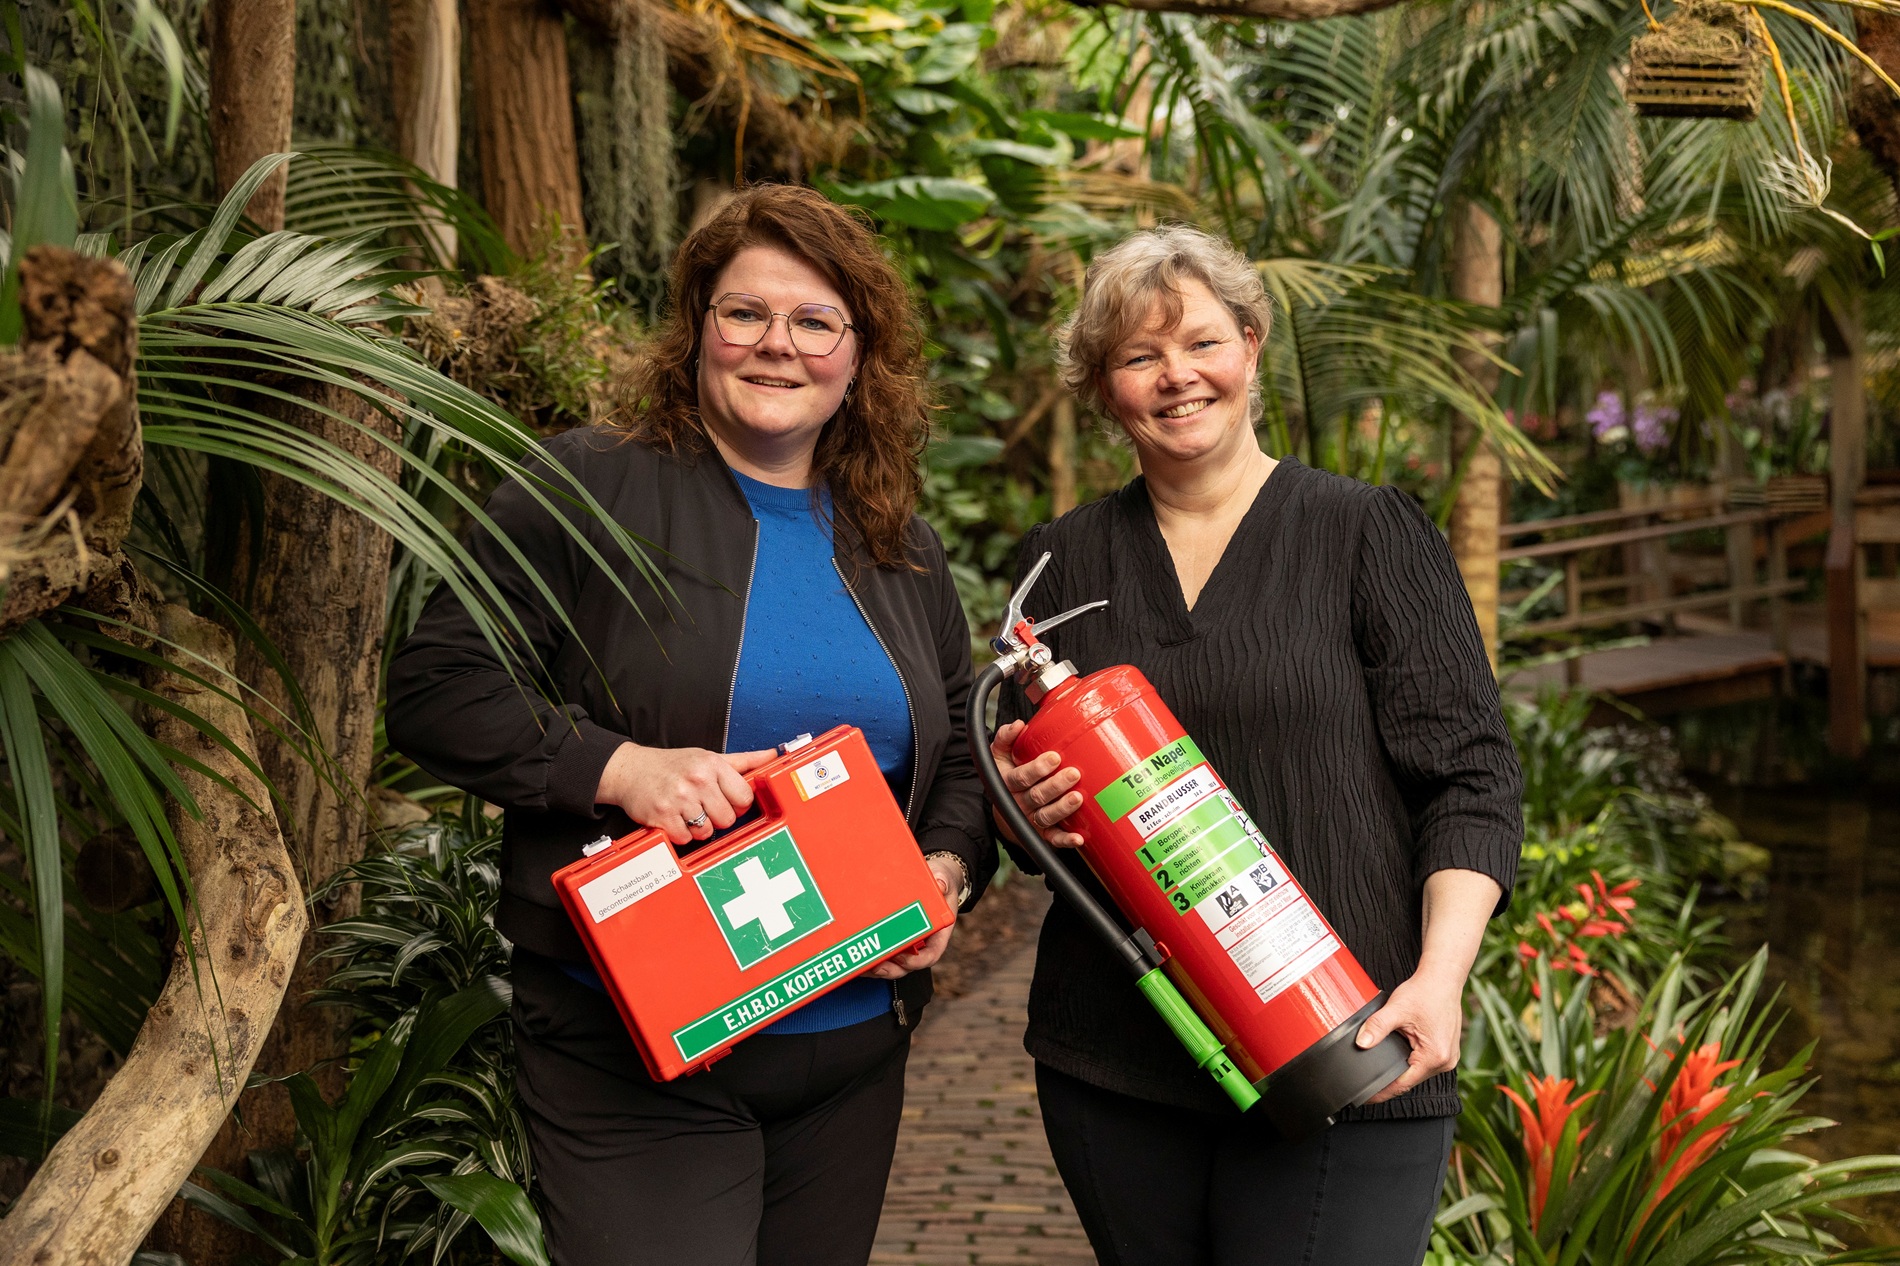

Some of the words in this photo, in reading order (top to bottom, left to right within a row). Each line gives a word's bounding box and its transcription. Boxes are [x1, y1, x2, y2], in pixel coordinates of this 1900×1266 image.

[1121, 766, 1153, 790] Ten
[1150, 742, 1187, 771] Napel
[1135, 758, 1192, 798] Brandbeveiliging
[1138, 778, 1199, 824] BRANDBLUSSER
[1157, 823, 1186, 847] Borgpen
[1163, 824, 1201, 854] wegtrekken
[1141, 847, 1156, 865] 1
[1178, 858, 1202, 876] richten
[1258, 863, 1268, 874] B
[612, 870, 653, 896] Schaatsbaan
[1156, 869, 1175, 890] 2
[1189, 866, 1223, 892] Knijpkraan
[1195, 874, 1226, 899] indrukken
[1229, 885, 1240, 896] A
[598, 887, 644, 917] gecontroleerd
[644, 881, 655, 892] op
[654, 868, 677, 886] 8-1-26
[1173, 892, 1191, 911] 3
[722, 989, 785, 1032] E.H.B.O.
[782, 952, 848, 999] KOFFER
[846, 932, 882, 964] BHV
